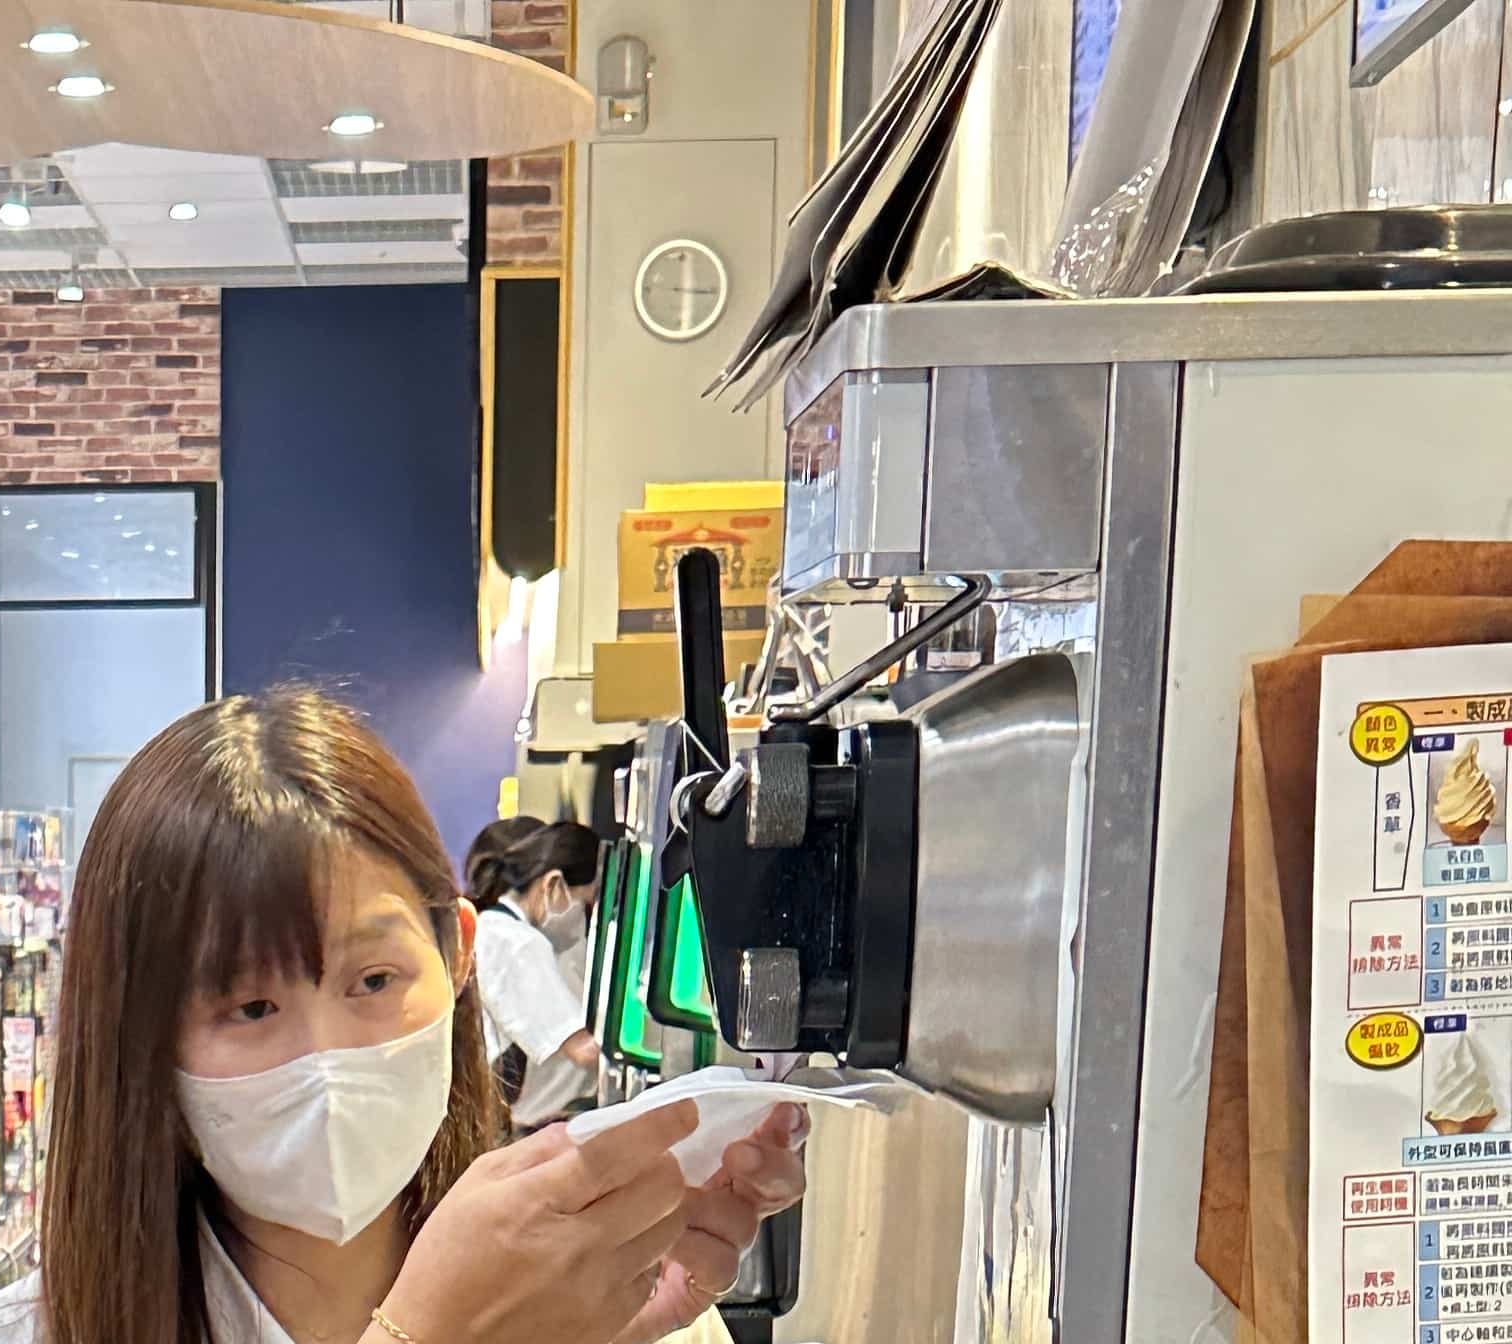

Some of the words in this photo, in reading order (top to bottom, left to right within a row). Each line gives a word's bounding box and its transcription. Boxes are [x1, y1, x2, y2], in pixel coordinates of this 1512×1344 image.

[1431, 903, 1441, 918] 1
[1431, 942, 1441, 956] 2
[1430, 980, 1441, 994] 3
[1424, 1234, 1434, 1247] 1
[1424, 1286, 1434, 1300] 2
[1425, 1329, 1435, 1344] 3
